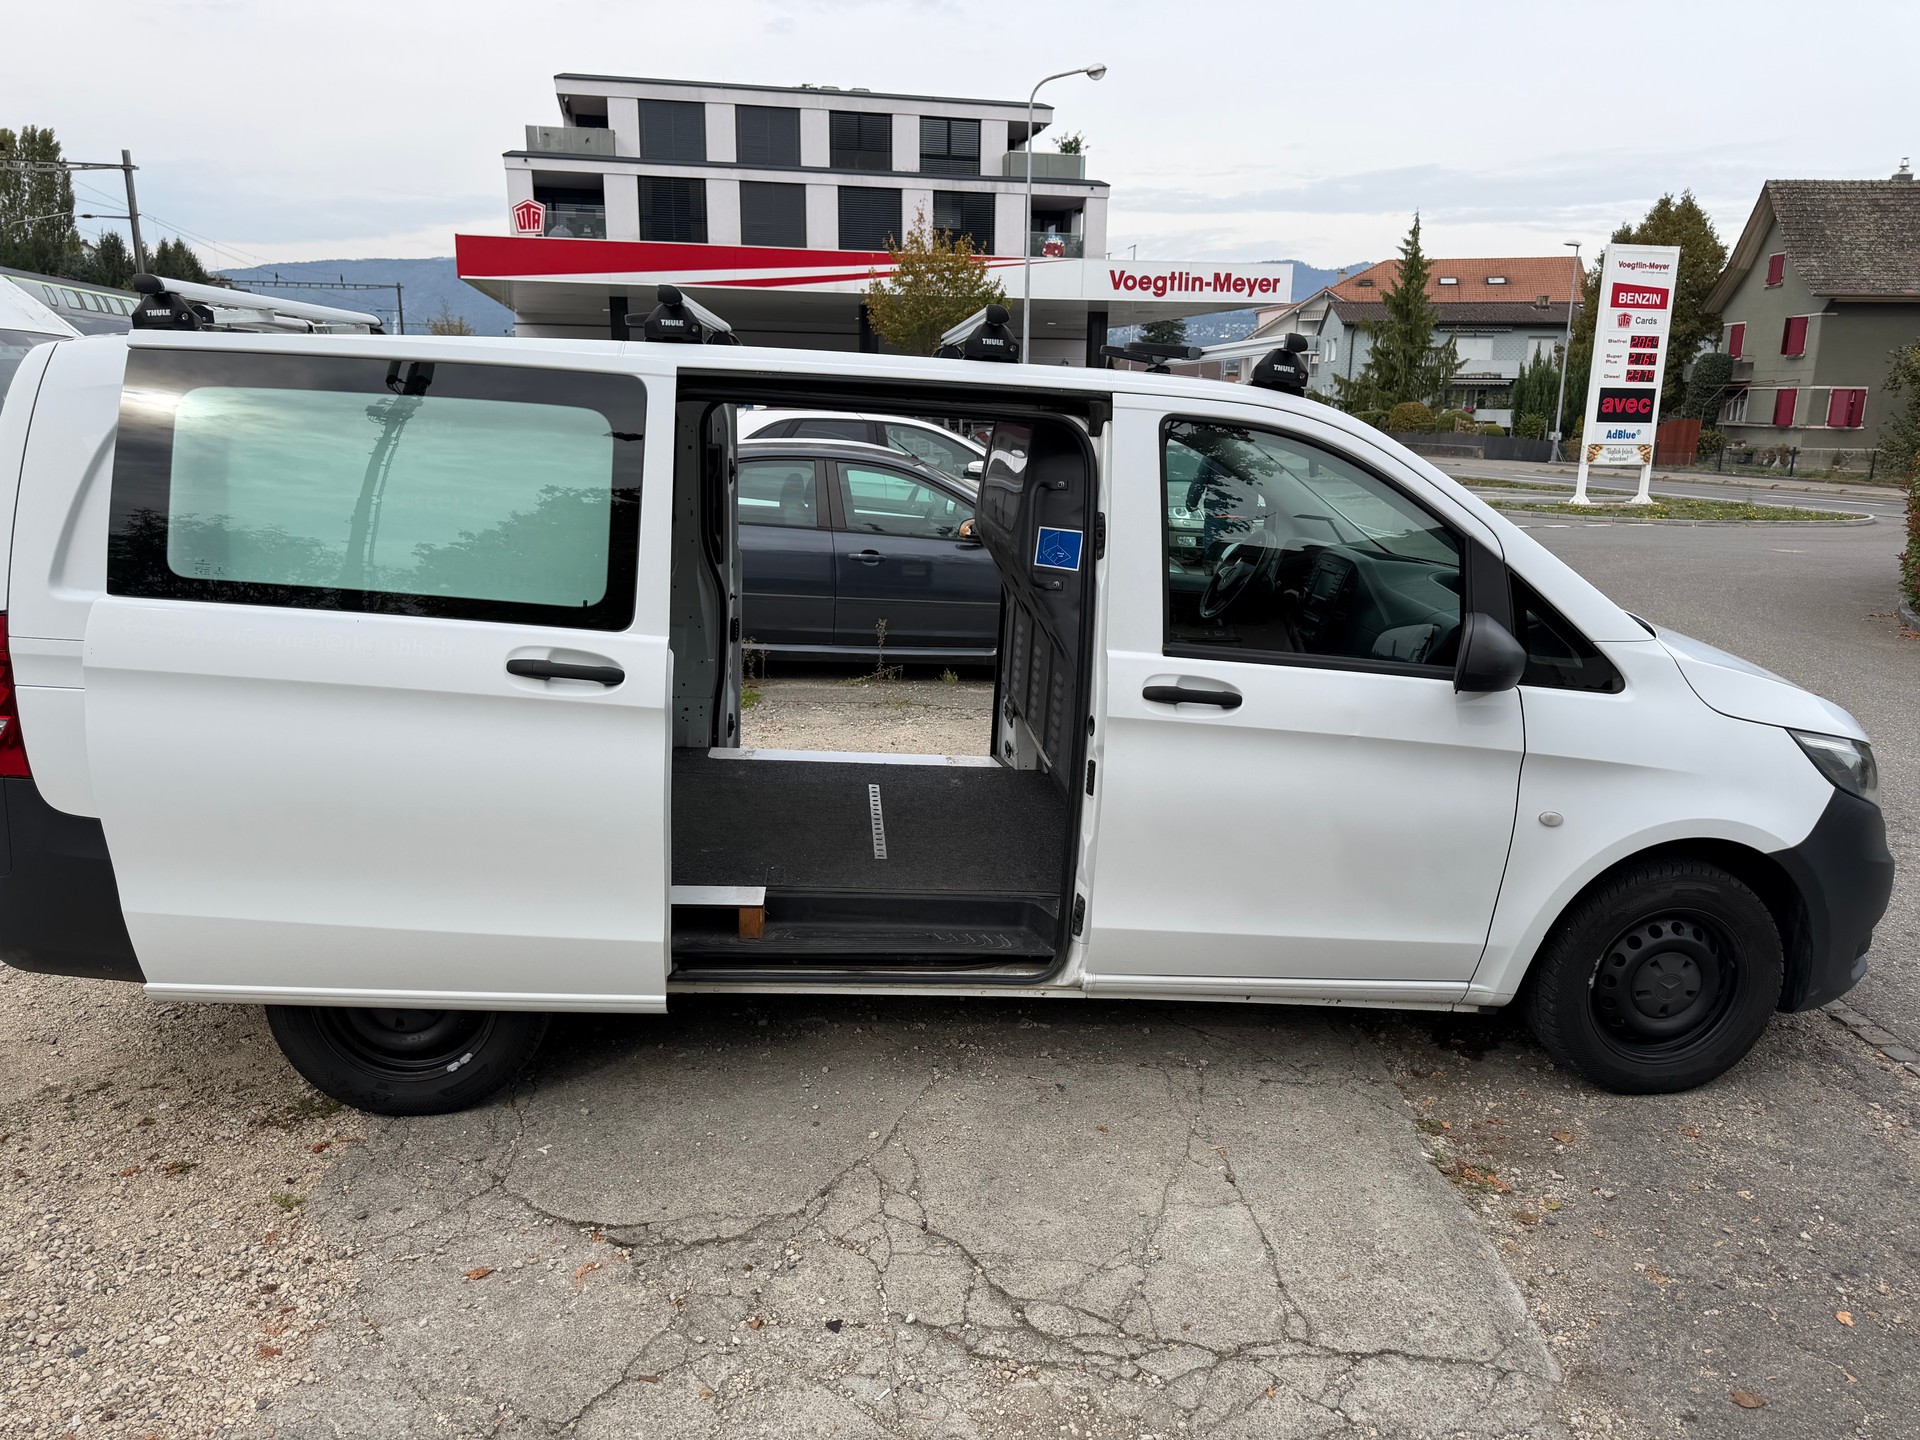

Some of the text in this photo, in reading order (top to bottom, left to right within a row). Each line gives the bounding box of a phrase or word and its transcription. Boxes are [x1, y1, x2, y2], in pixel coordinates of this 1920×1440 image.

[514, 201, 542, 231] UTA
[1618, 260, 1670, 271] Voegtlin-Meyer
[1109, 269, 1281, 298] Voegtlin-Meyer
[1618, 292, 1661, 305] BENZIN
[146, 309, 171, 317] THULE
[660, 319, 684, 327] THULE
[1635, 316, 1658, 325] Cards
[981, 338, 1004, 346] THULE
[1273, 364, 1295, 374] THULE
[1601, 397, 1651, 414] avec
